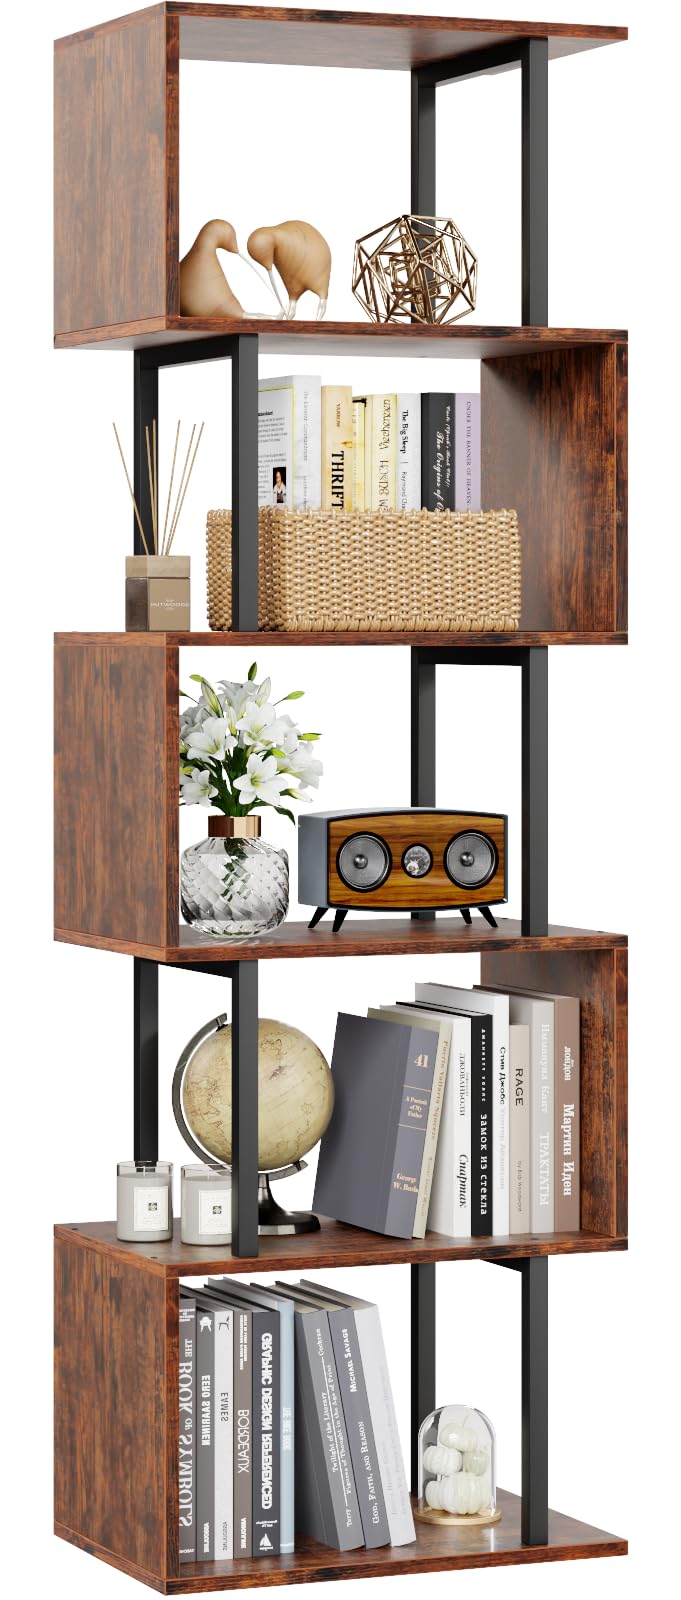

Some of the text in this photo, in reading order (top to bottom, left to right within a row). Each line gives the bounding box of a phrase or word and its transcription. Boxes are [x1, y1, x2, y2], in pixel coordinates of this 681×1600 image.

[400, 423, 409, 435] Big
[400, 436, 409, 454] Sleep
[436, 431, 444, 449] The
[331, 450, 344, 510] THRIFT
[379, 460, 390, 496] BUSCH
[433, 452, 445, 488] Origins
[466, 467, 472, 476] OF
[433, 489, 444, 501] of
[414, 1054, 429, 1068] 41
[498, 1072, 506, 1105] Джобс
[515, 1068, 524, 1106] RAGE
[561, 1103, 575, 1196] Мартин Иден
[456, 1154, 469, 1208] Спартак
[539, 1131, 550, 1205] ТРАКТАТЫ
